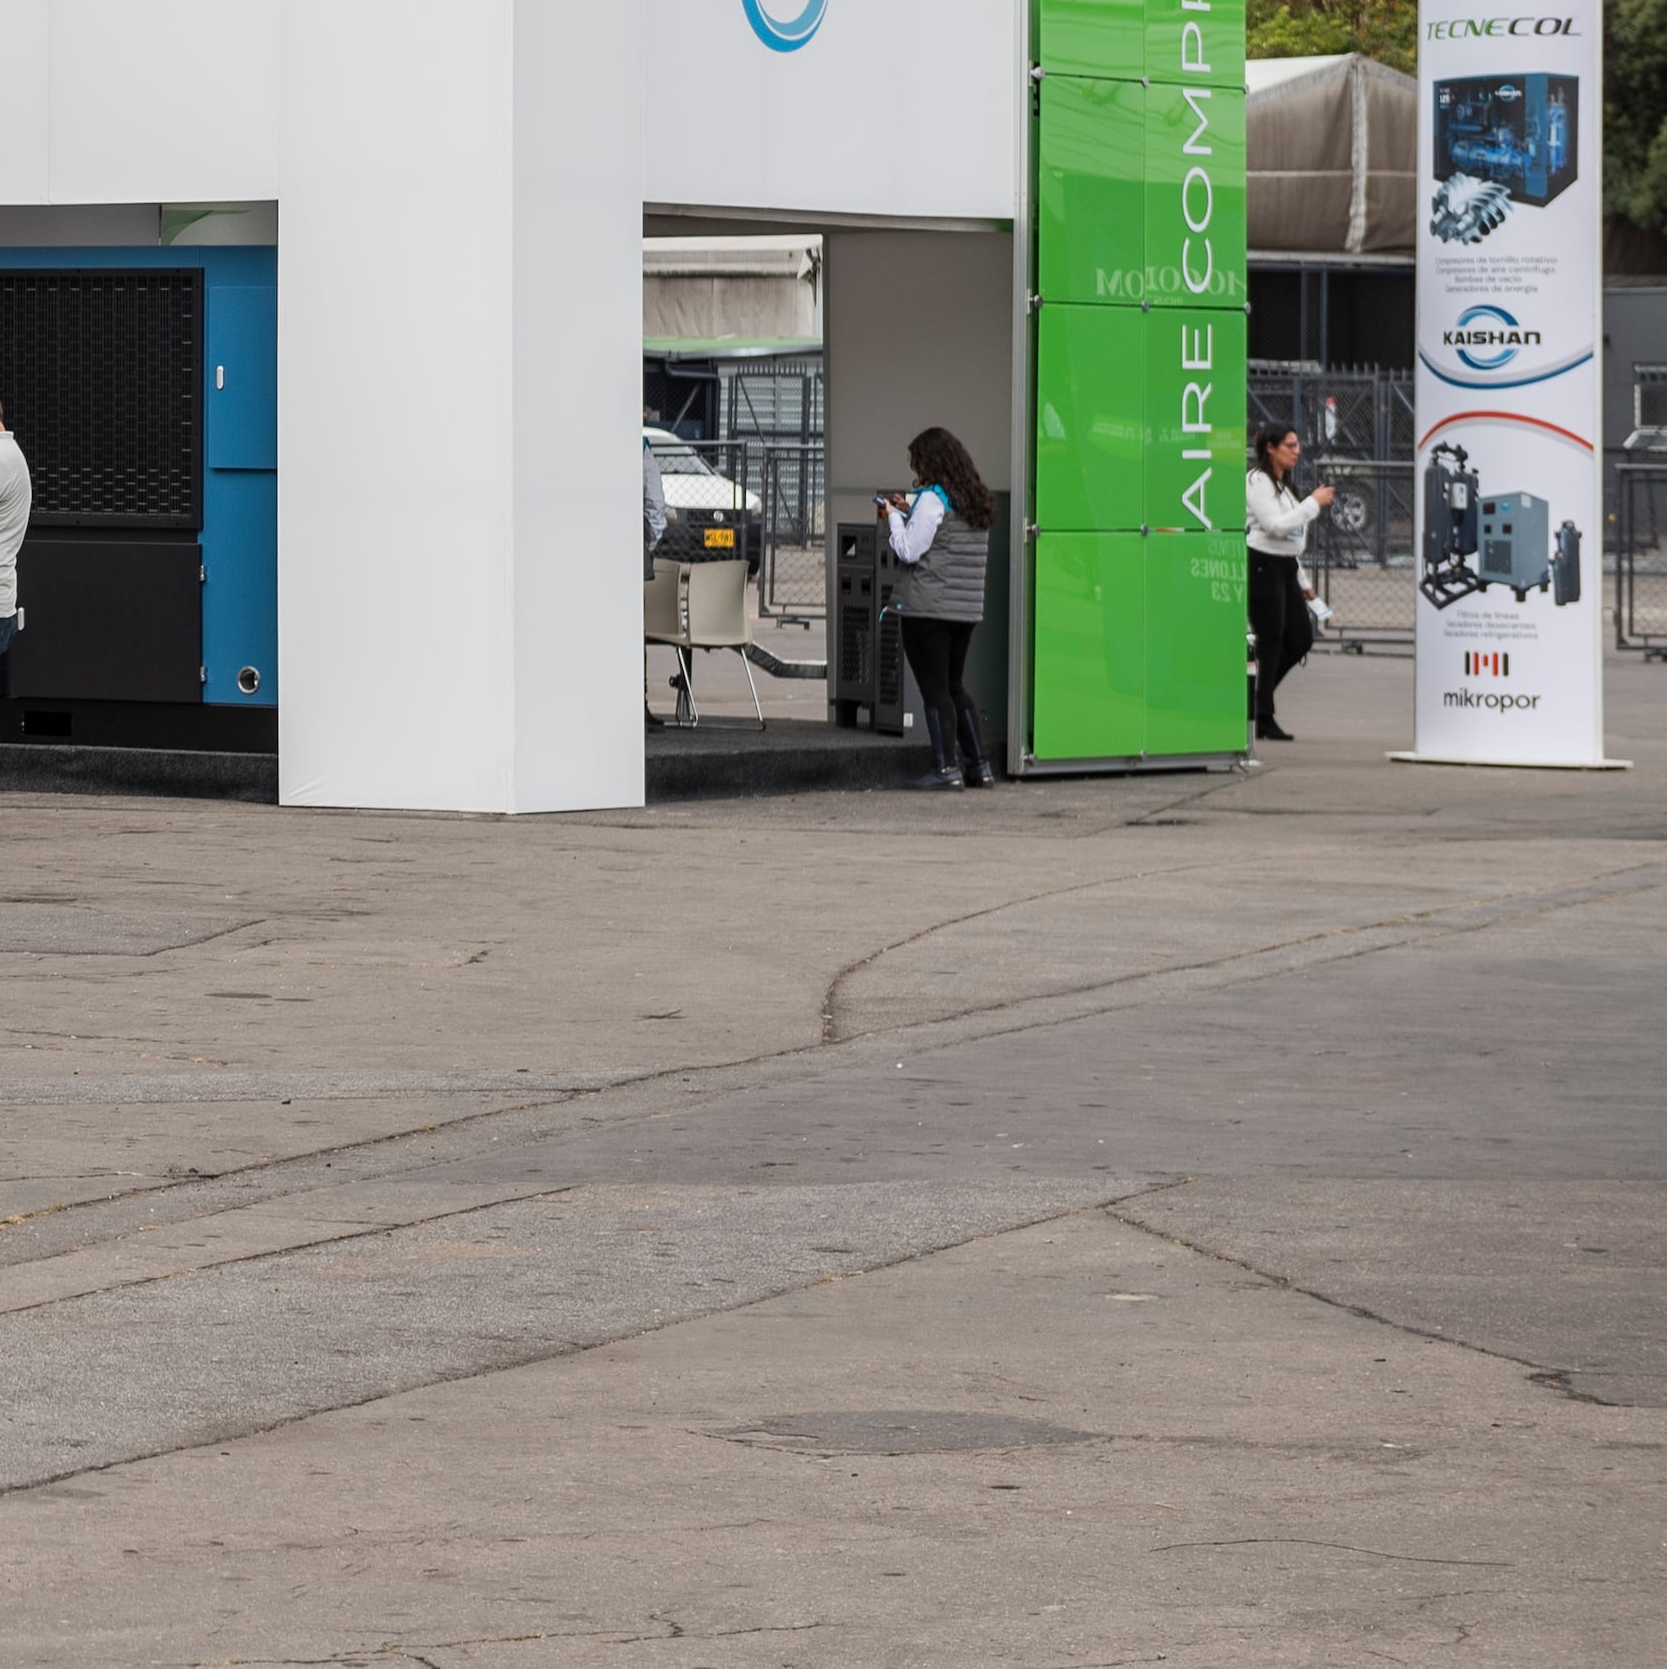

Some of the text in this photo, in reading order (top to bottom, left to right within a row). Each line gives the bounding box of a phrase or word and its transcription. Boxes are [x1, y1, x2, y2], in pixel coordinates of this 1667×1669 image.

[1427, 17, 1582, 41] TECNECOL
[1443, 331, 1541, 345] KAISHAN
[1181, 323, 1212, 530] AIRE
[1444, 687, 1540, 713] mikropor
